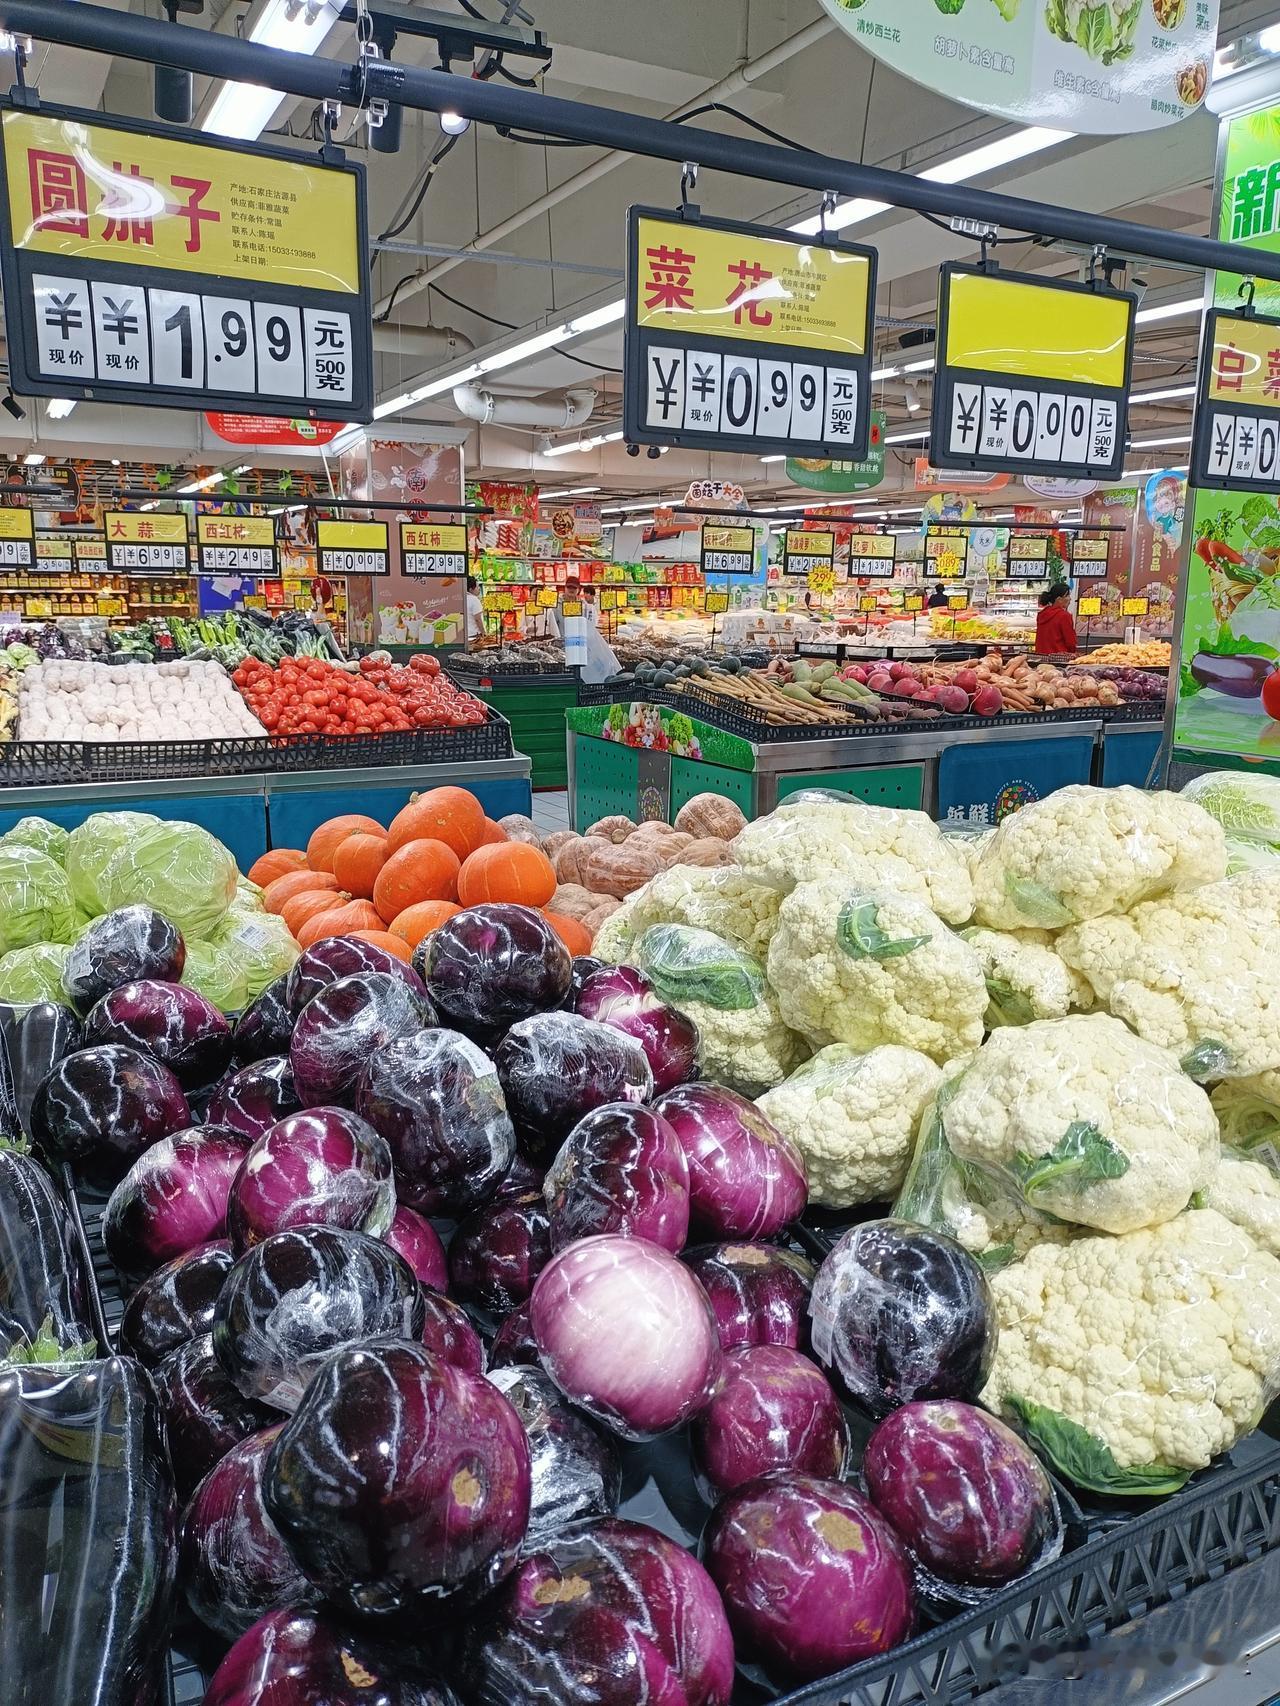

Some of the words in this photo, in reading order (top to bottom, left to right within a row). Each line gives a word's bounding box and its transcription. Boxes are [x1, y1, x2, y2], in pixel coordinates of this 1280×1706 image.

[856, 18, 901, 43] 清炒西兰花
[934, 35, 1015, 75] 胡萝卜素含量高
[27, 148, 221, 253] 圆茄子
[49, 349, 84, 367] 现价
[106, 353, 140, 371] 现价
[690, 409, 713, 422] 现价
[986, 436, 1004, 448] 现价
[1235, 461, 1250, 471] 现价
[691, 482, 743, 500] 菌菇干大全
[111, 520, 154, 538] 大蒜
[405, 531, 441, 547] 西红柿
